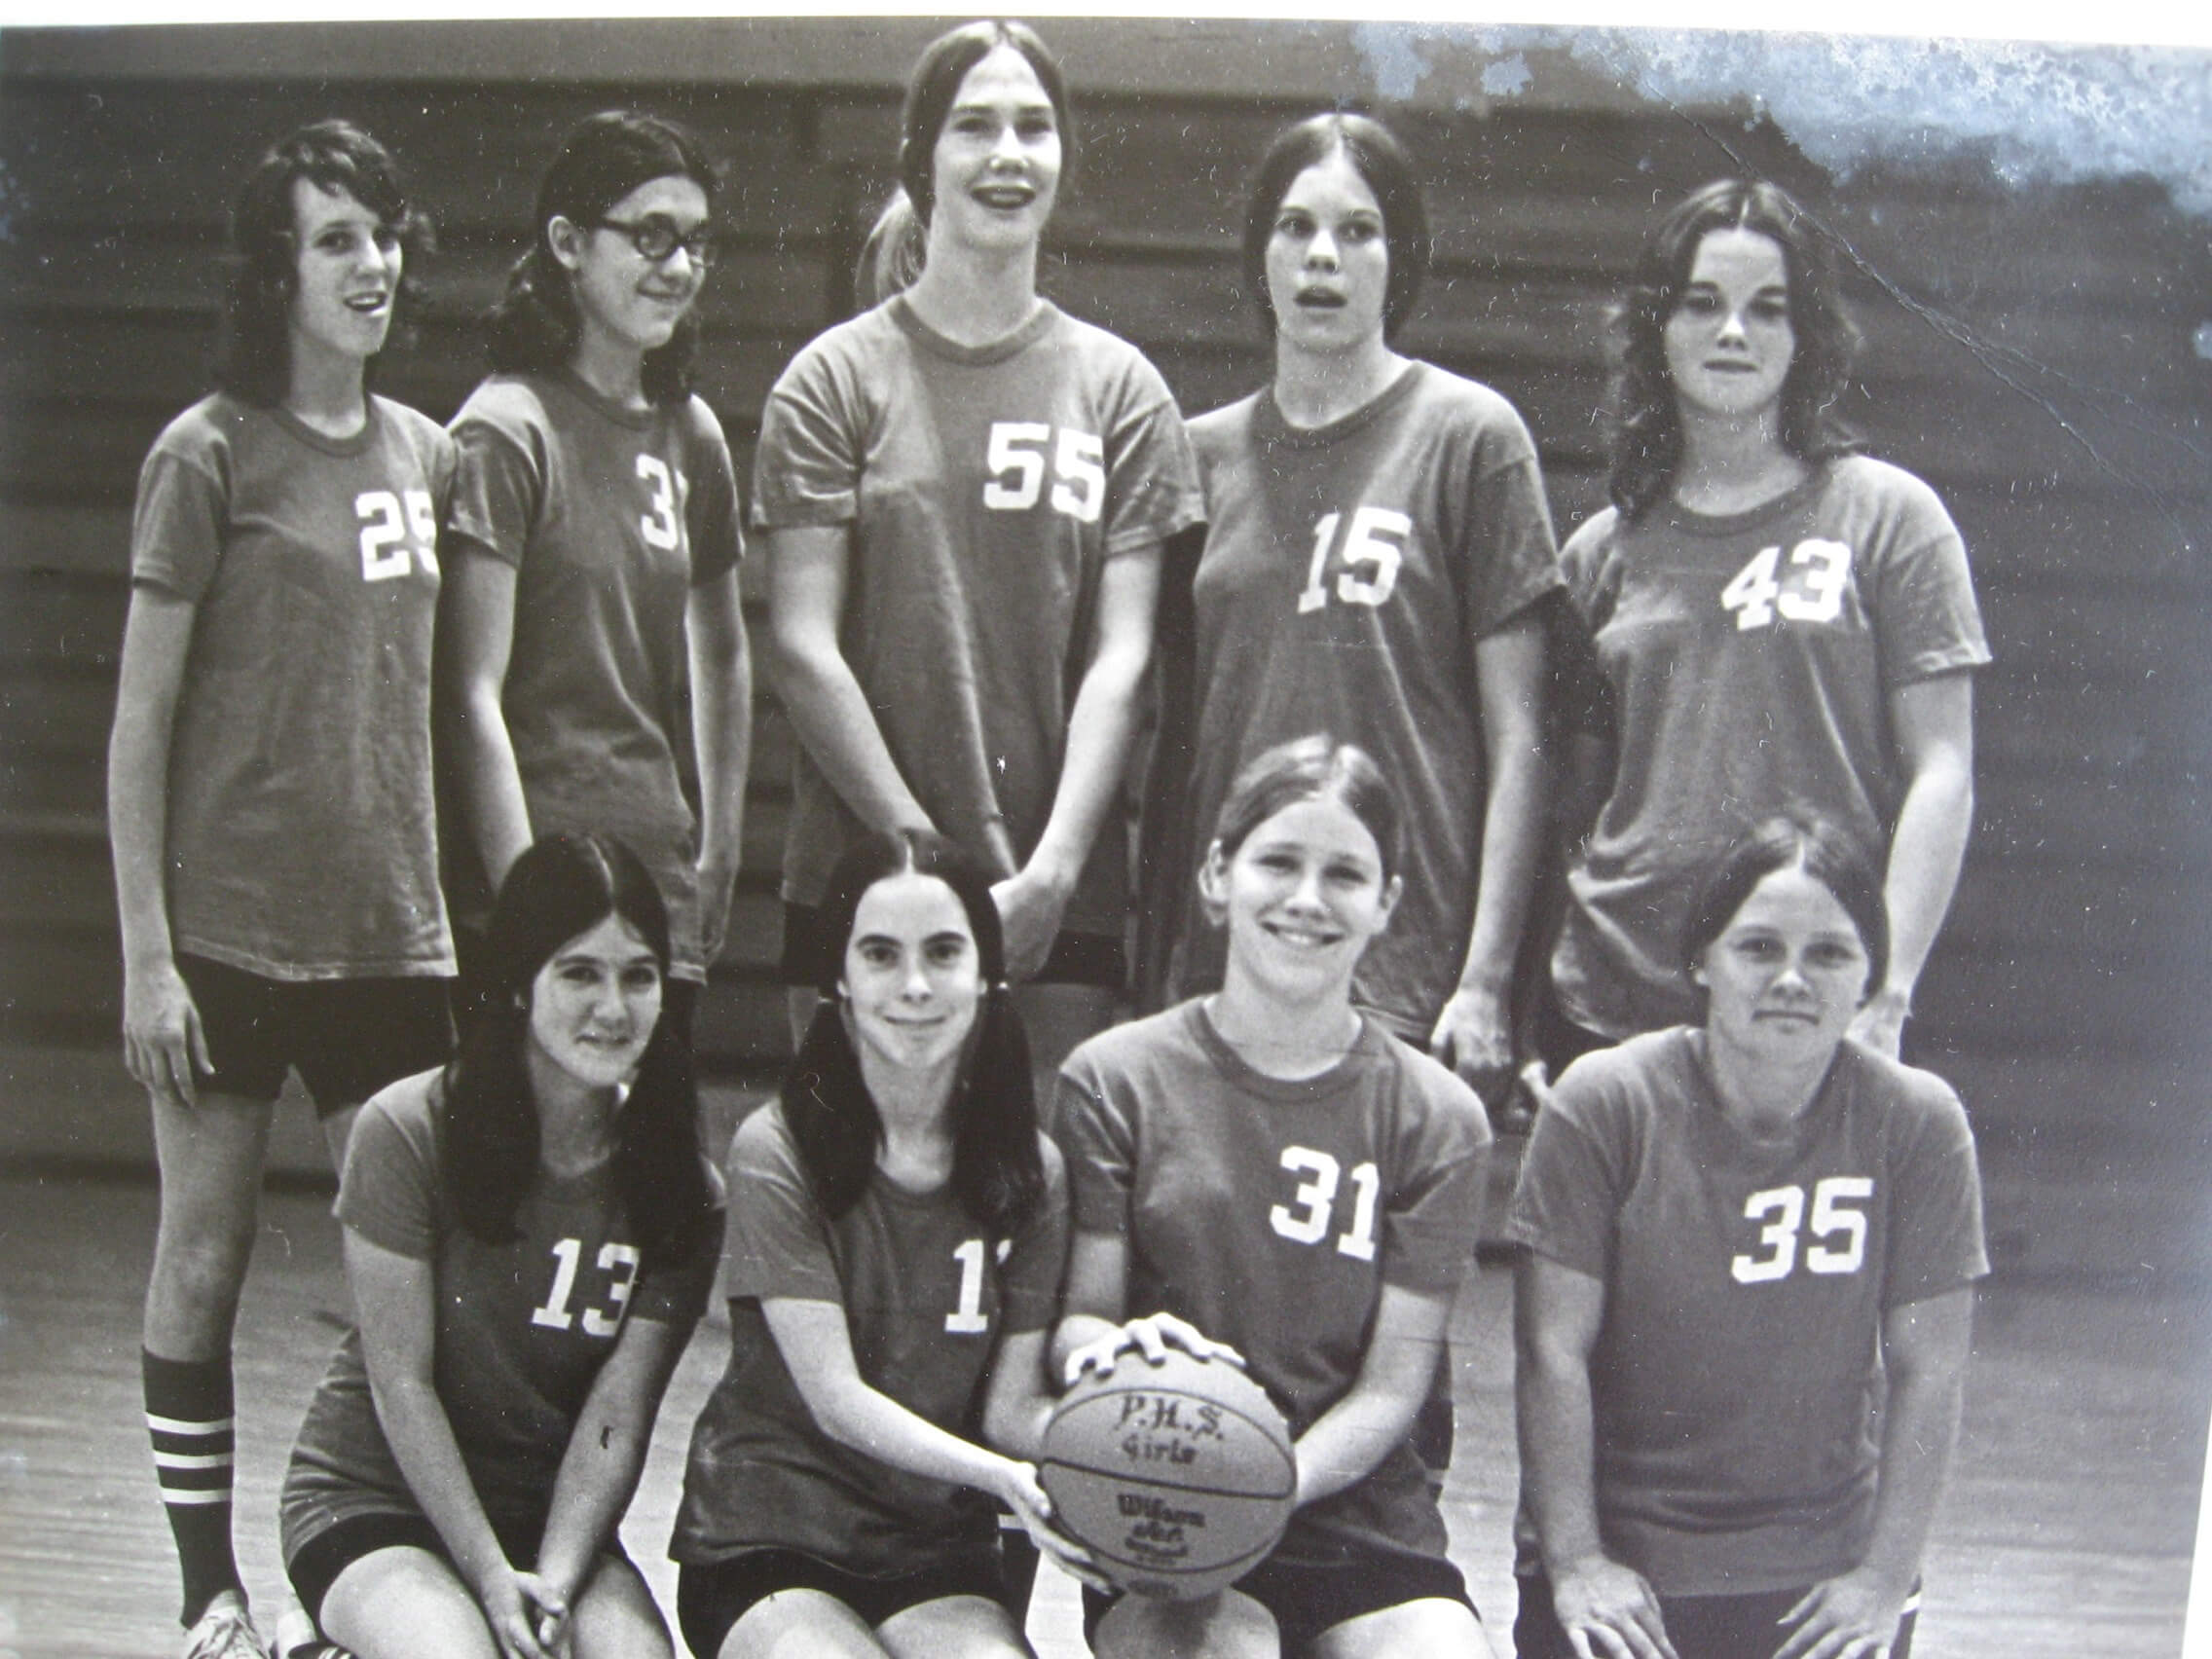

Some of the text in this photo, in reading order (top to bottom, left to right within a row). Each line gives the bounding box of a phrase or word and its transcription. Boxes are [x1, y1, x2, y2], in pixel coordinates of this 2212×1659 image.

[636, 454, 689, 551] 3
[983, 422, 1105, 523] 55
[1298, 506, 1412, 613] 15
[1721, 538, 1852, 631] 43
[1270, 1145, 1380, 1261] 31
[1731, 1177, 1873, 1284] 35
[531, 1237, 640, 1337] 13
[944, 1238, 1013, 1333] 1
